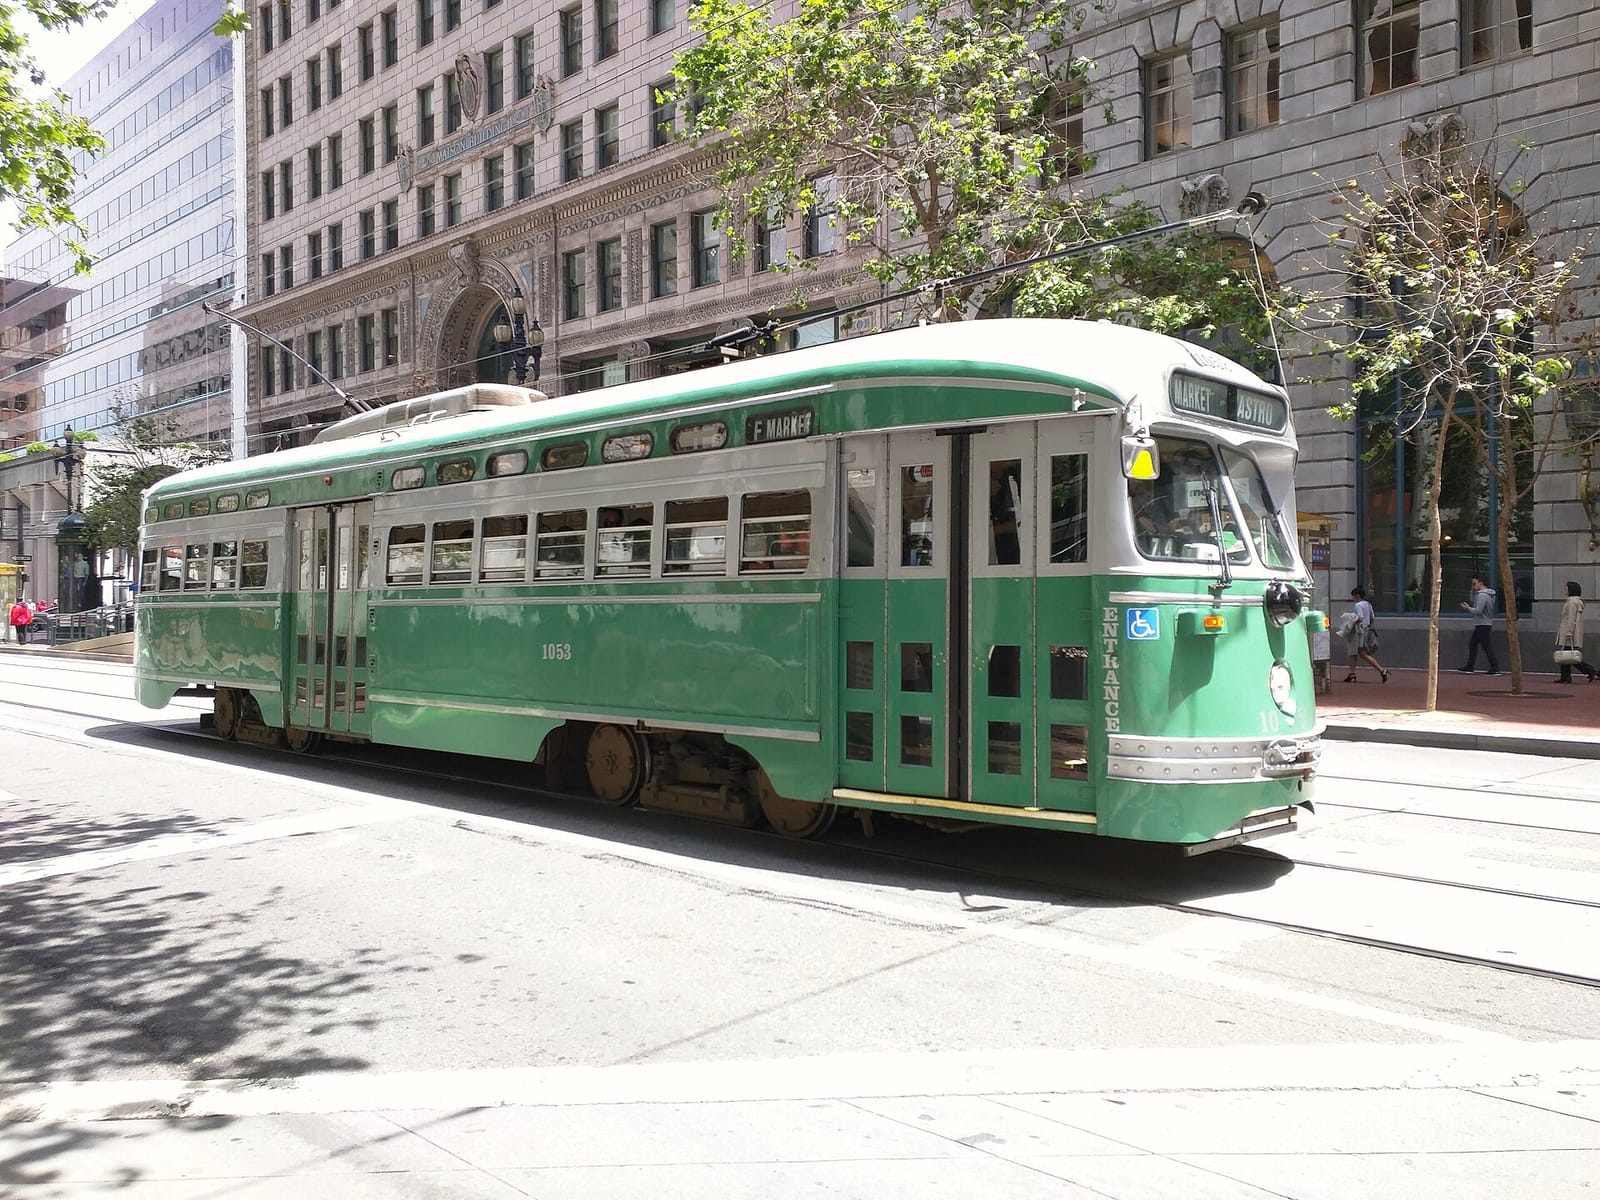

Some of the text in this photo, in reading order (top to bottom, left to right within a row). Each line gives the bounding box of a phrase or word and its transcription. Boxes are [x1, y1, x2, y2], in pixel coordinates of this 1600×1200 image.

[470, 120, 509, 147] BUILDING
[1174, 378, 1273, 426] MARKET ASTRO
[754, 420, 763, 441] F
[542, 642, 572, 660] 1053
[1103, 607, 1120, 732] ENTRANCE
